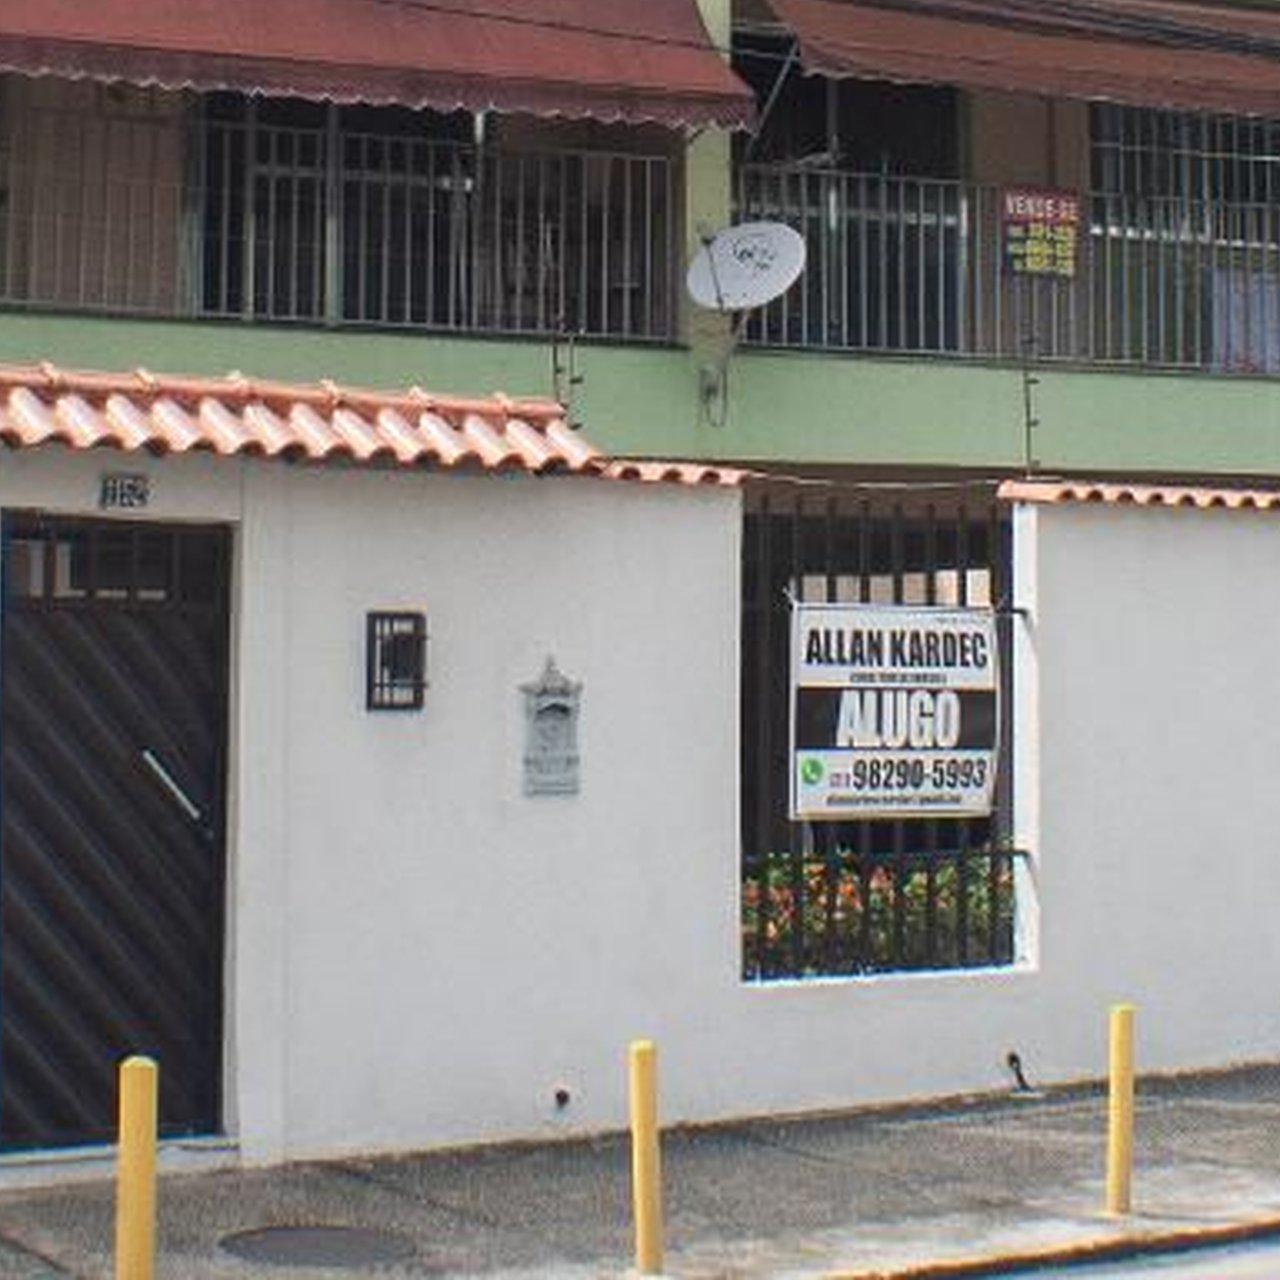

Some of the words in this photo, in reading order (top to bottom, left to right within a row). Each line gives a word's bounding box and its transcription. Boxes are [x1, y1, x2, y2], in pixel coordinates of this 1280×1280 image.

[806, 629, 883, 667] ALLAN
[891, 629, 989, 669] KARDEC
[835, 689, 961, 749] ALUGO
